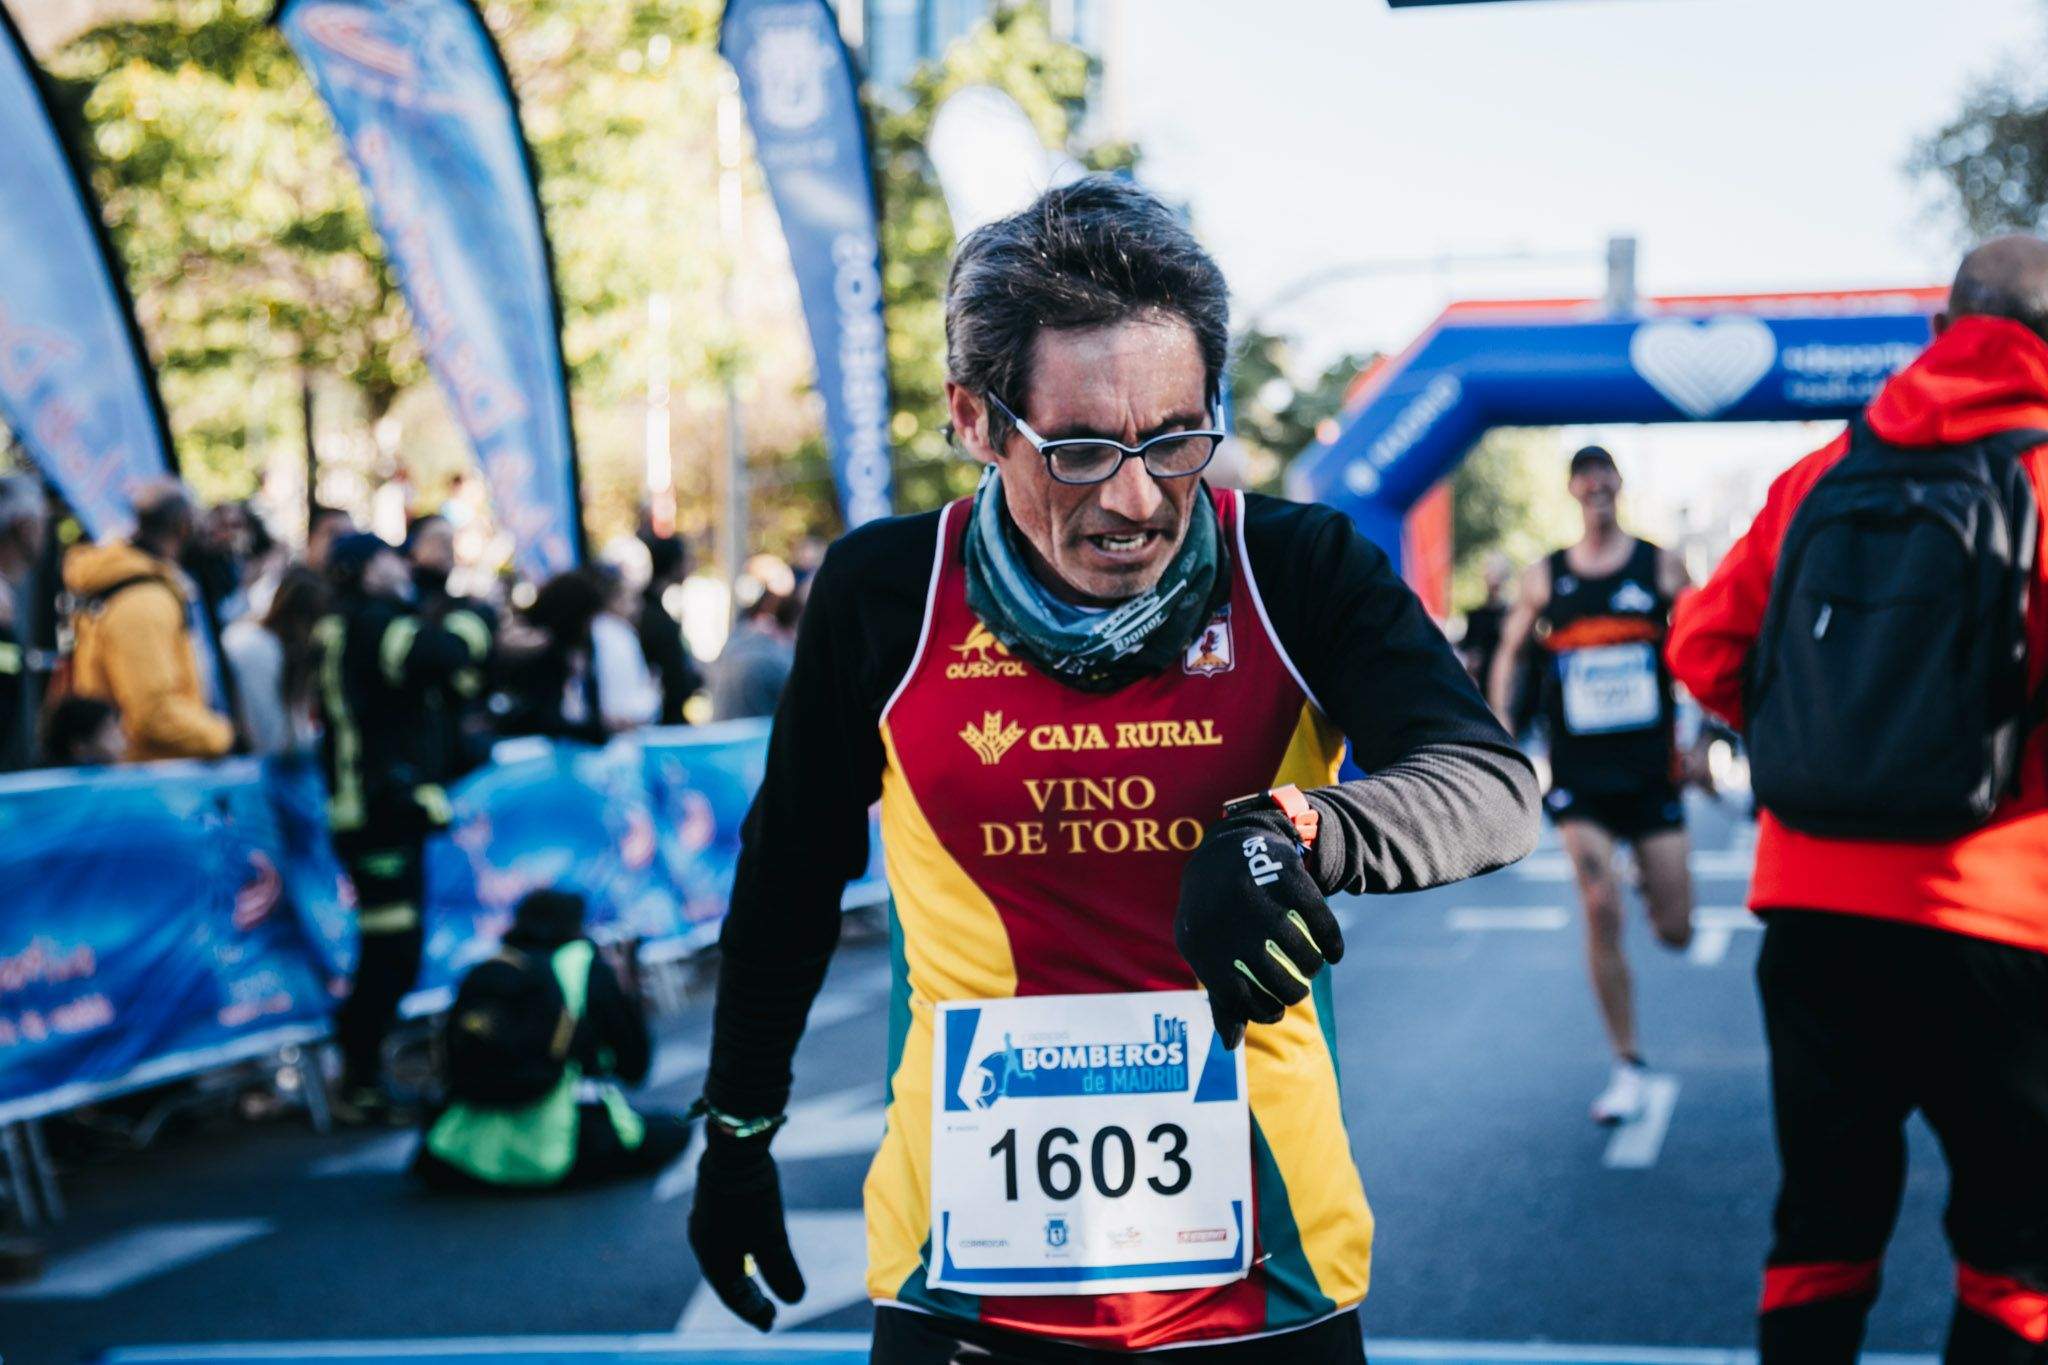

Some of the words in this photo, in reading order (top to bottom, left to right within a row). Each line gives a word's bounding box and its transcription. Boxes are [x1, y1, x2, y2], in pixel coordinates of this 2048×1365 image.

[1028, 722, 1110, 752] CAJA
[1115, 719, 1223, 749] RURAL
[1022, 775, 1156, 813] VINO
[980, 821, 1048, 857] DE
[1059, 816, 1204, 855] TORO
[1021, 1042, 1184, 1071] BOMBEROS
[1082, 1070, 1105, 1092] de
[1112, 1067, 1185, 1092] MADRID
[990, 1123, 1192, 1201] 1603
